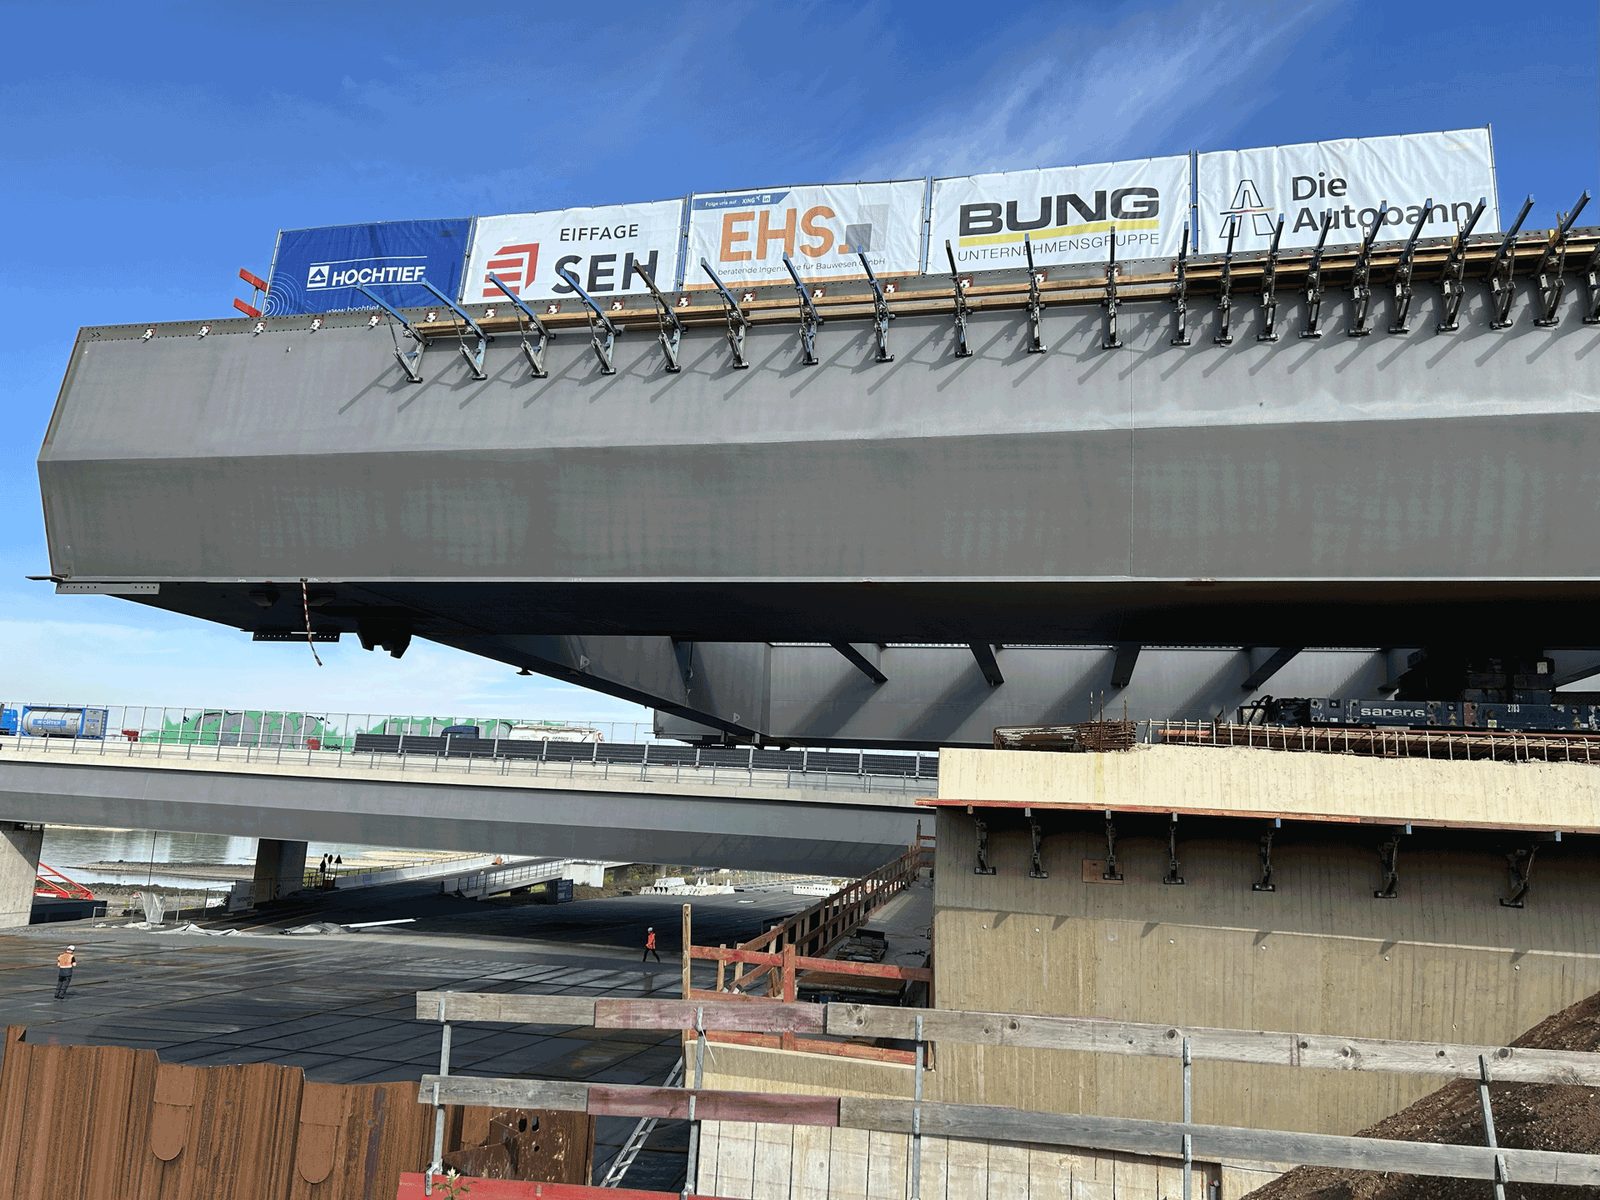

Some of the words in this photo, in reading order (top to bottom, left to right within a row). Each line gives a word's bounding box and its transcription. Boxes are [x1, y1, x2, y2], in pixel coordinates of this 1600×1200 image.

[1292, 172, 1347, 201] Die
[959, 187, 1159, 237] BUNG
[559, 223, 639, 242] EIFFAGE
[331, 265, 426, 287] HOCHTIEF
[551, 250, 659, 294] SEH
[717, 266, 758, 276] beratende
[759, 264, 801, 275] Ingeniere
[803, 262, 814, 271] für
[816, 260, 857, 270] Bauwesen
[1361, 707, 1425, 718] sarens
